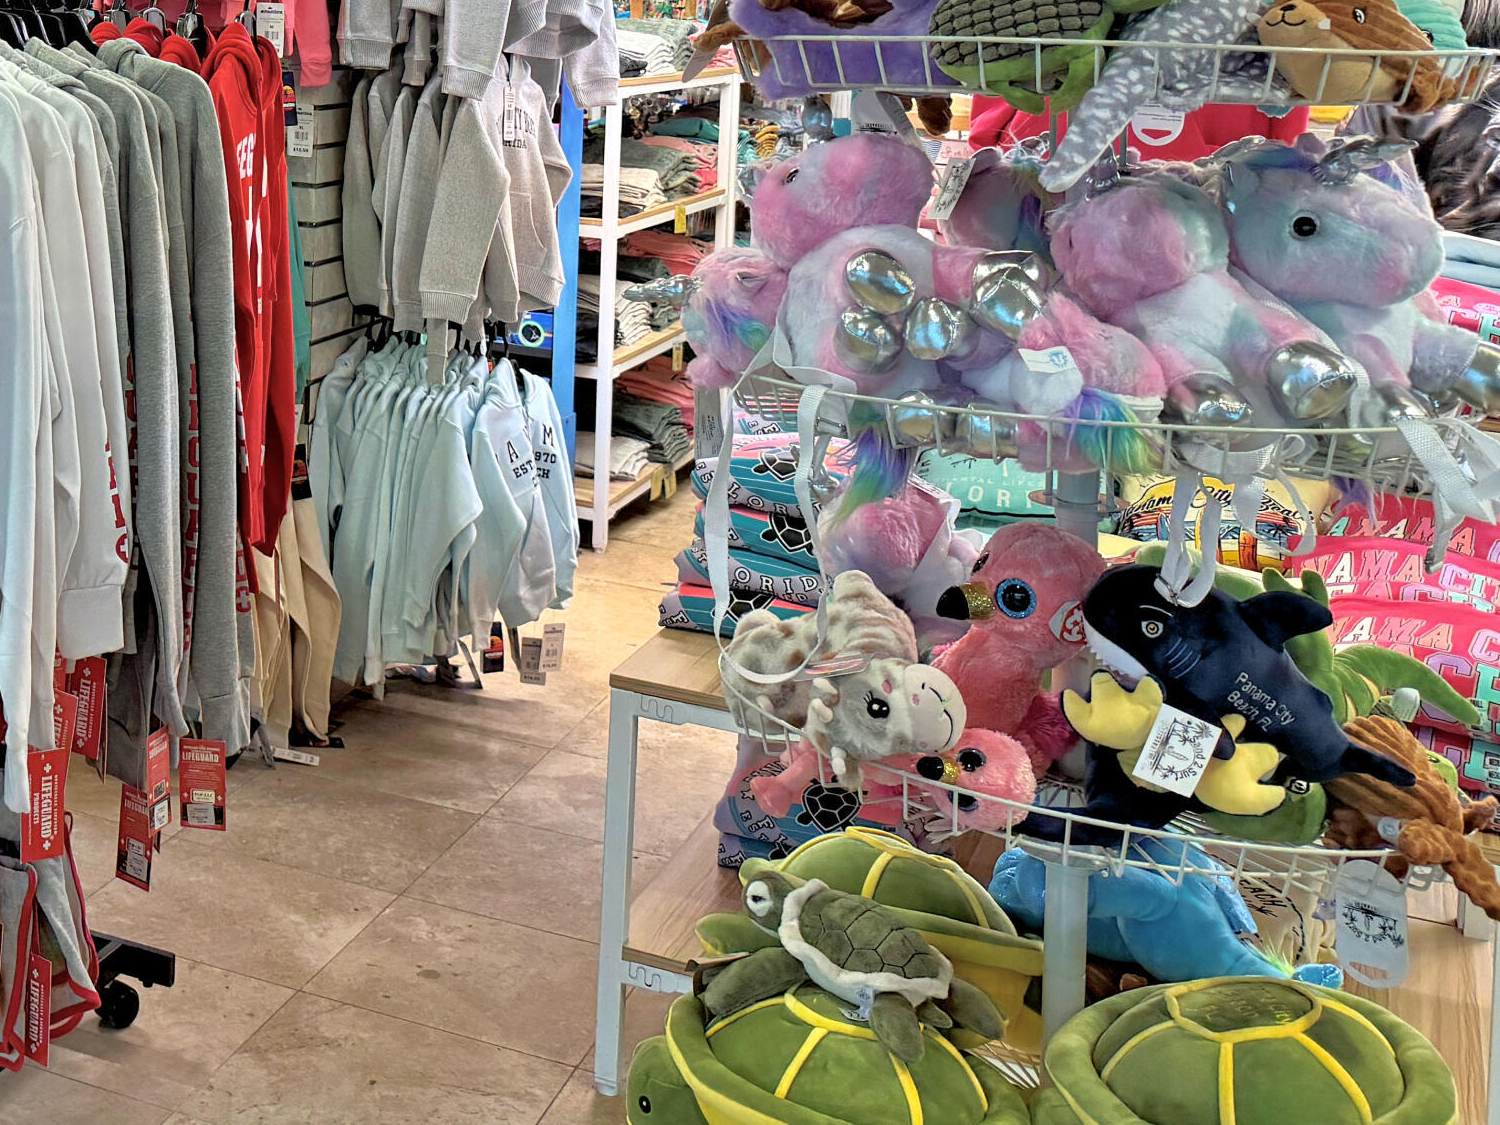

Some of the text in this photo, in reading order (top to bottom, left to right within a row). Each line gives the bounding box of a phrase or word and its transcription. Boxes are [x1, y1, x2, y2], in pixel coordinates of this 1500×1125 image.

[76, 678, 91, 740] LIFEGUARD
[1235, 671, 1296, 725] Panama City
[1256, 716, 1273, 732] FL
[182, 751, 219, 763] LIFEGUARD
[40, 775, 53, 838] LIFEGUARD
[29, 979, 40, 1042] LIFEGUARD
